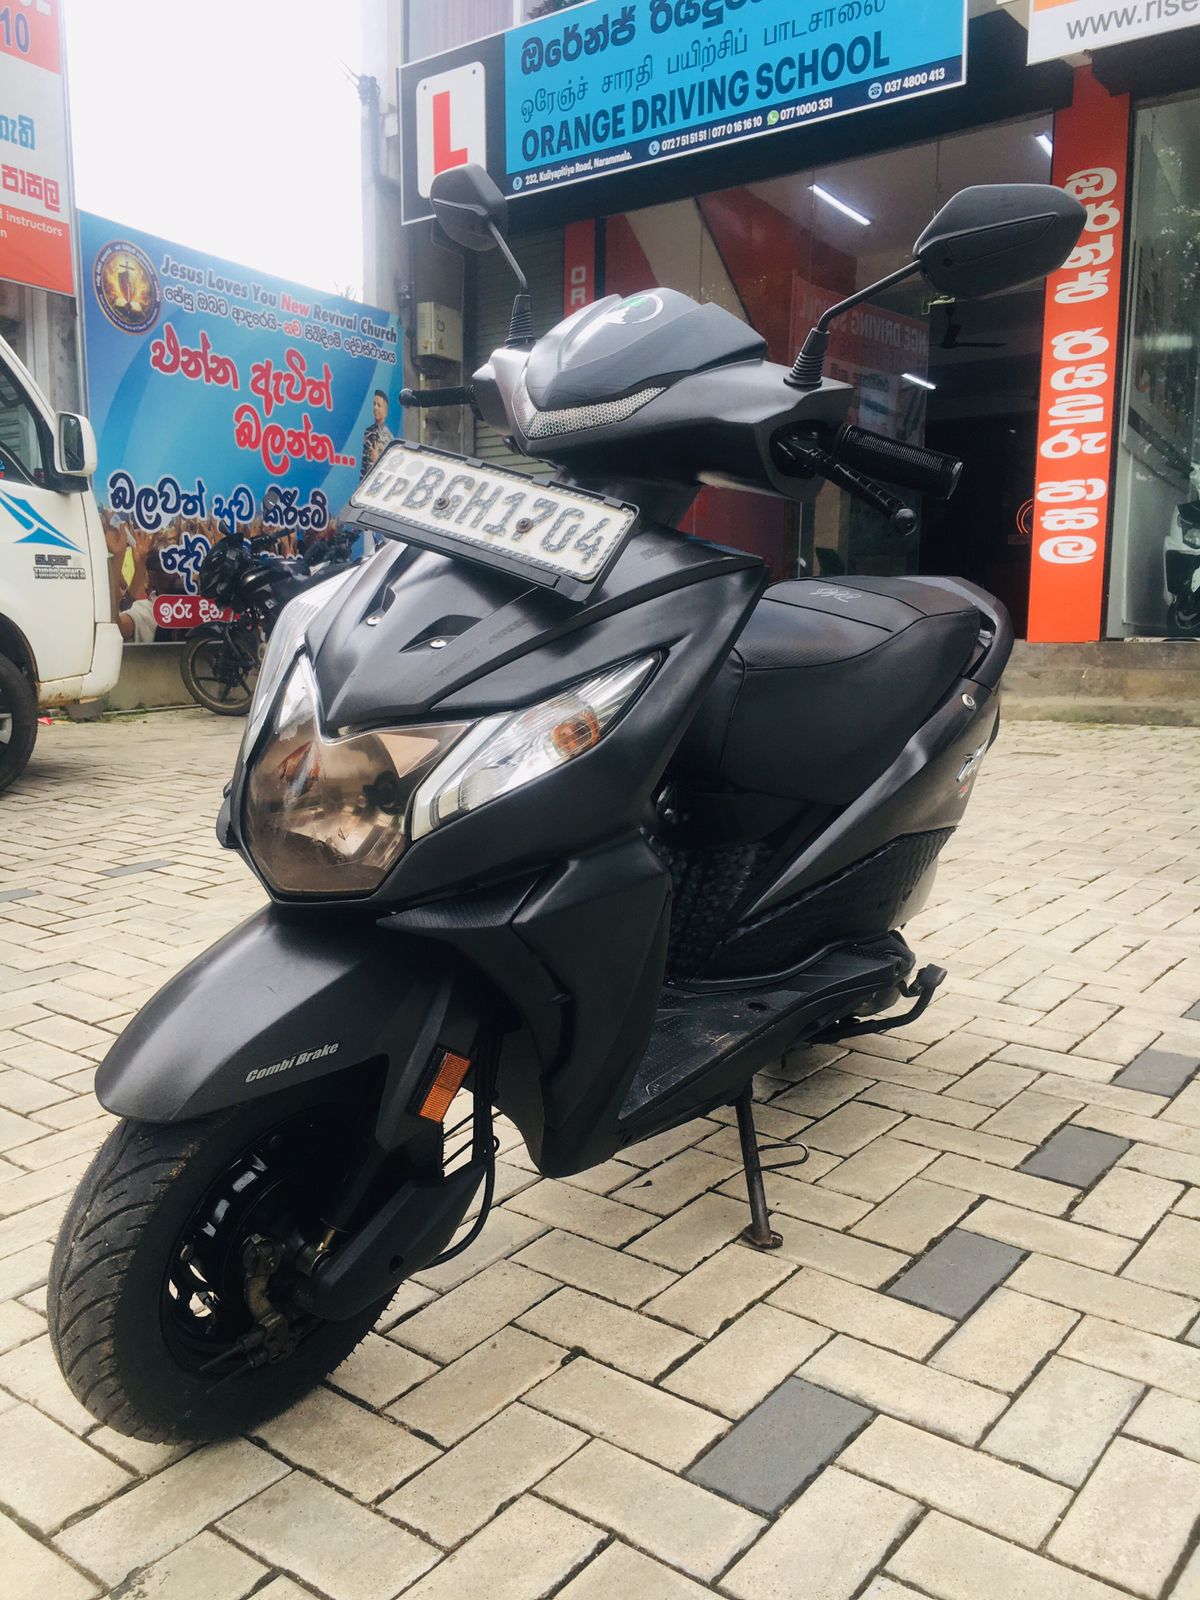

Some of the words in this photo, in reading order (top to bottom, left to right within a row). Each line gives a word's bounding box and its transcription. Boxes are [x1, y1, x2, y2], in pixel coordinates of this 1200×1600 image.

[521, 76, 588, 123] ஒரேஞ்ச்
[601, 54, 653, 94] சாரதி
[667, 27, 748, 74] பயிற்சிப்
[522, 103, 626, 161] ORANGE
[632, 70, 750, 134] DRIVING
[756, 30, 890, 100] SCHOOL
[928, 67, 945, 83] 413
[433, 91, 468, 176] L
[525, 173, 539, 186] 232,
[575, 158, 593, 173] Road,
[6, 210, 63, 237] instructors
[161, 256, 203, 285] Jesus
[208, 270, 249, 298] Loves
[252, 283, 277, 307] You
[281, 293, 310, 317] New
[313, 303, 358, 330] Revival
[361, 318, 397, 343] Church
[109, 472, 206, 530] බලවත්
[245, 1056, 297, 1083] Combi
[296, 1043, 339, 1066] Brake
